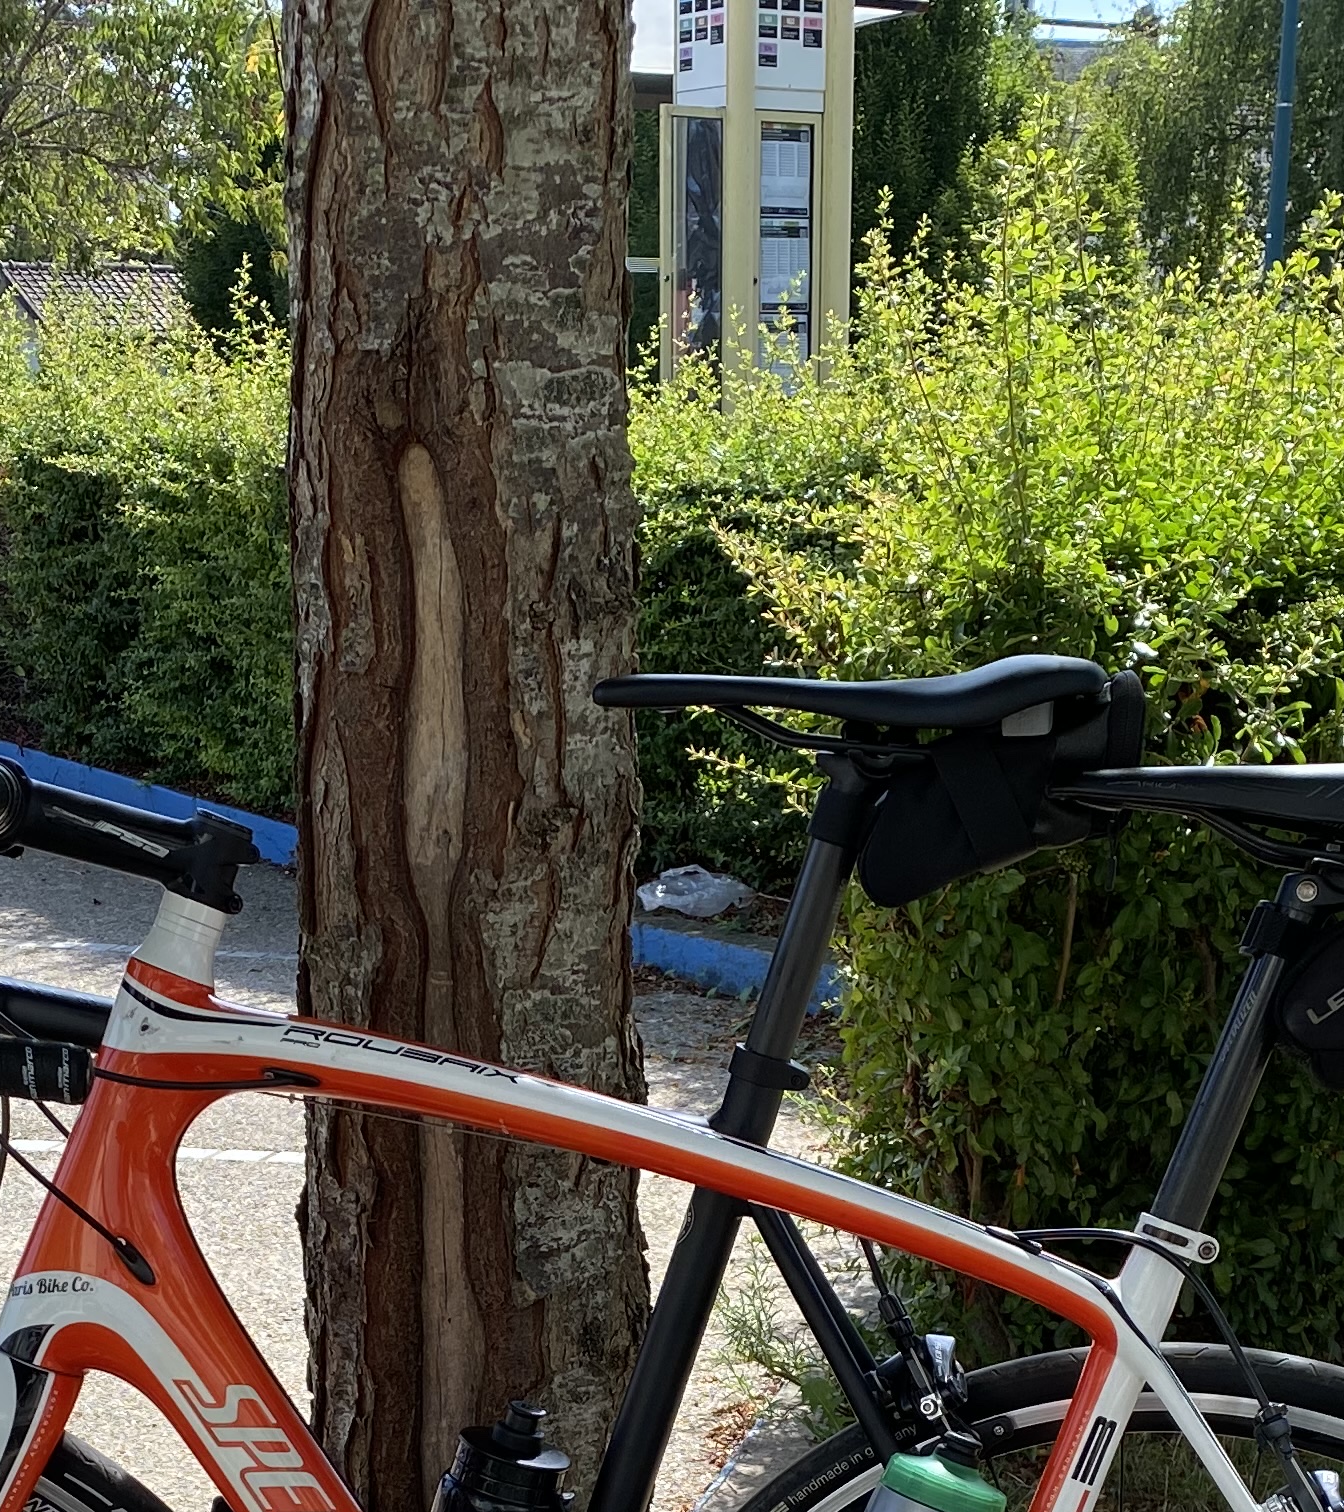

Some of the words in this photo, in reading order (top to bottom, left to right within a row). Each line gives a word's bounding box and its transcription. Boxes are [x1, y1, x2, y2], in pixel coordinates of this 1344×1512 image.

[283, 1025, 518, 1085] ROUBAIX
[36, 1278, 69, 1294] Bike
[72, 1275, 94, 1293] Co.
[787, 1460, 850, 1507] handmade
[850, 1450, 864, 1465] in
